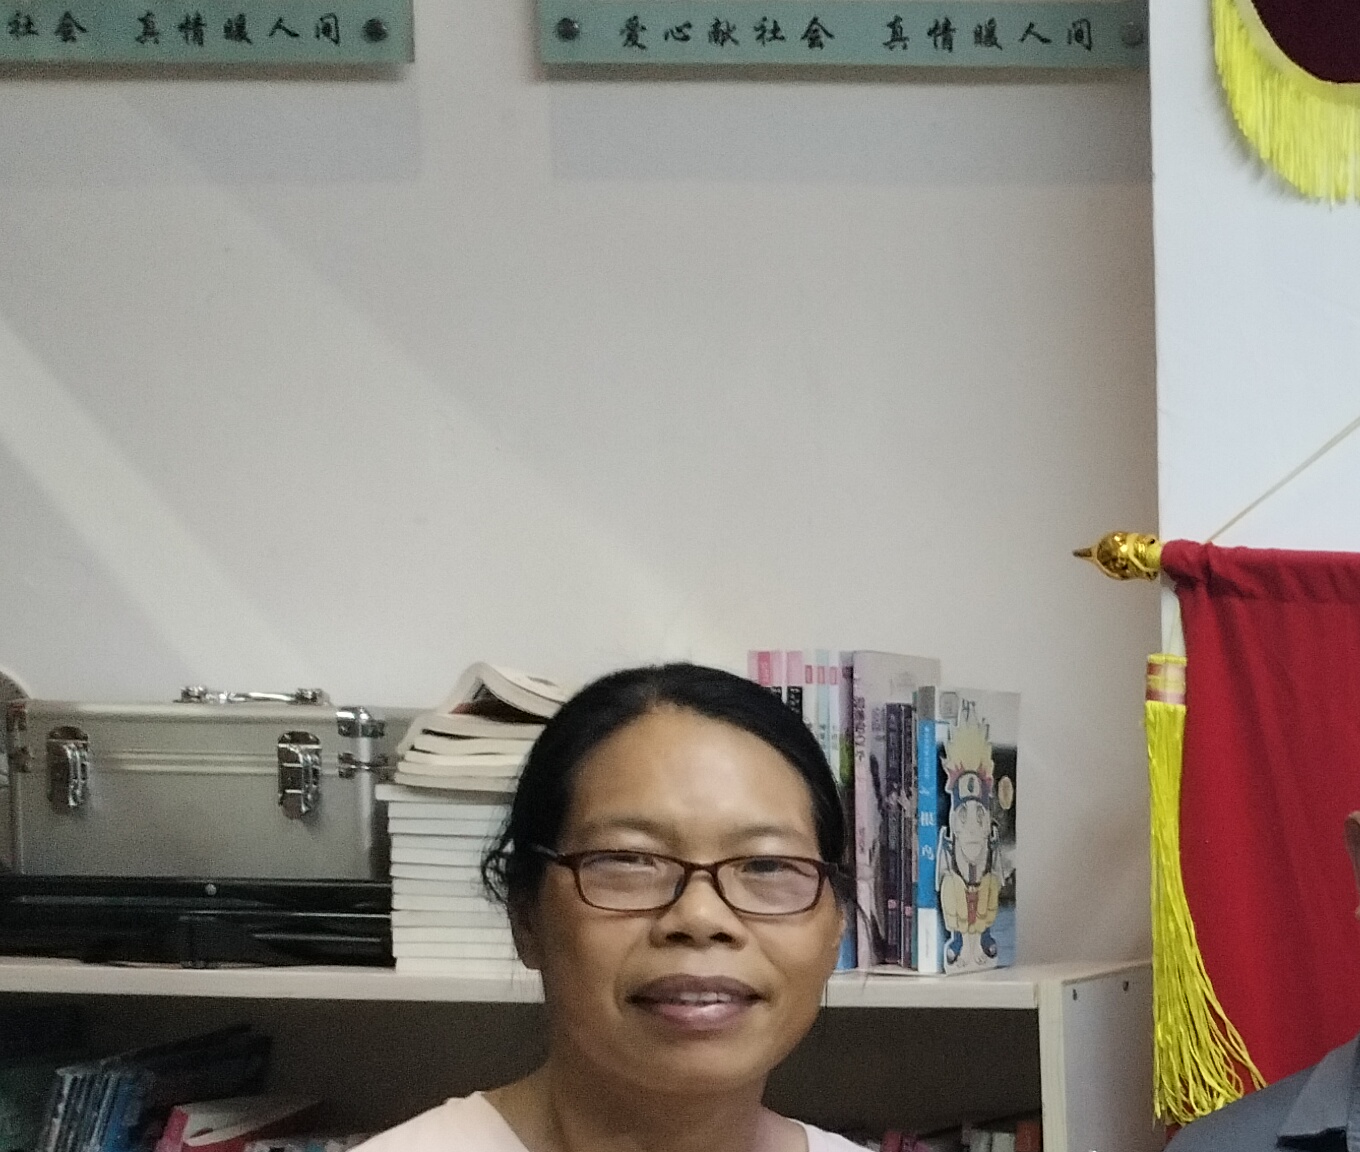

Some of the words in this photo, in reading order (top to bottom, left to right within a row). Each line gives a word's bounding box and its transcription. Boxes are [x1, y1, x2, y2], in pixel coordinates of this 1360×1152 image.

[135, 11, 341, 46] 真情暖人间
[619, 15, 835, 50] 爱心献社会
[883, 15, 1094, 52] 真情暖人间
